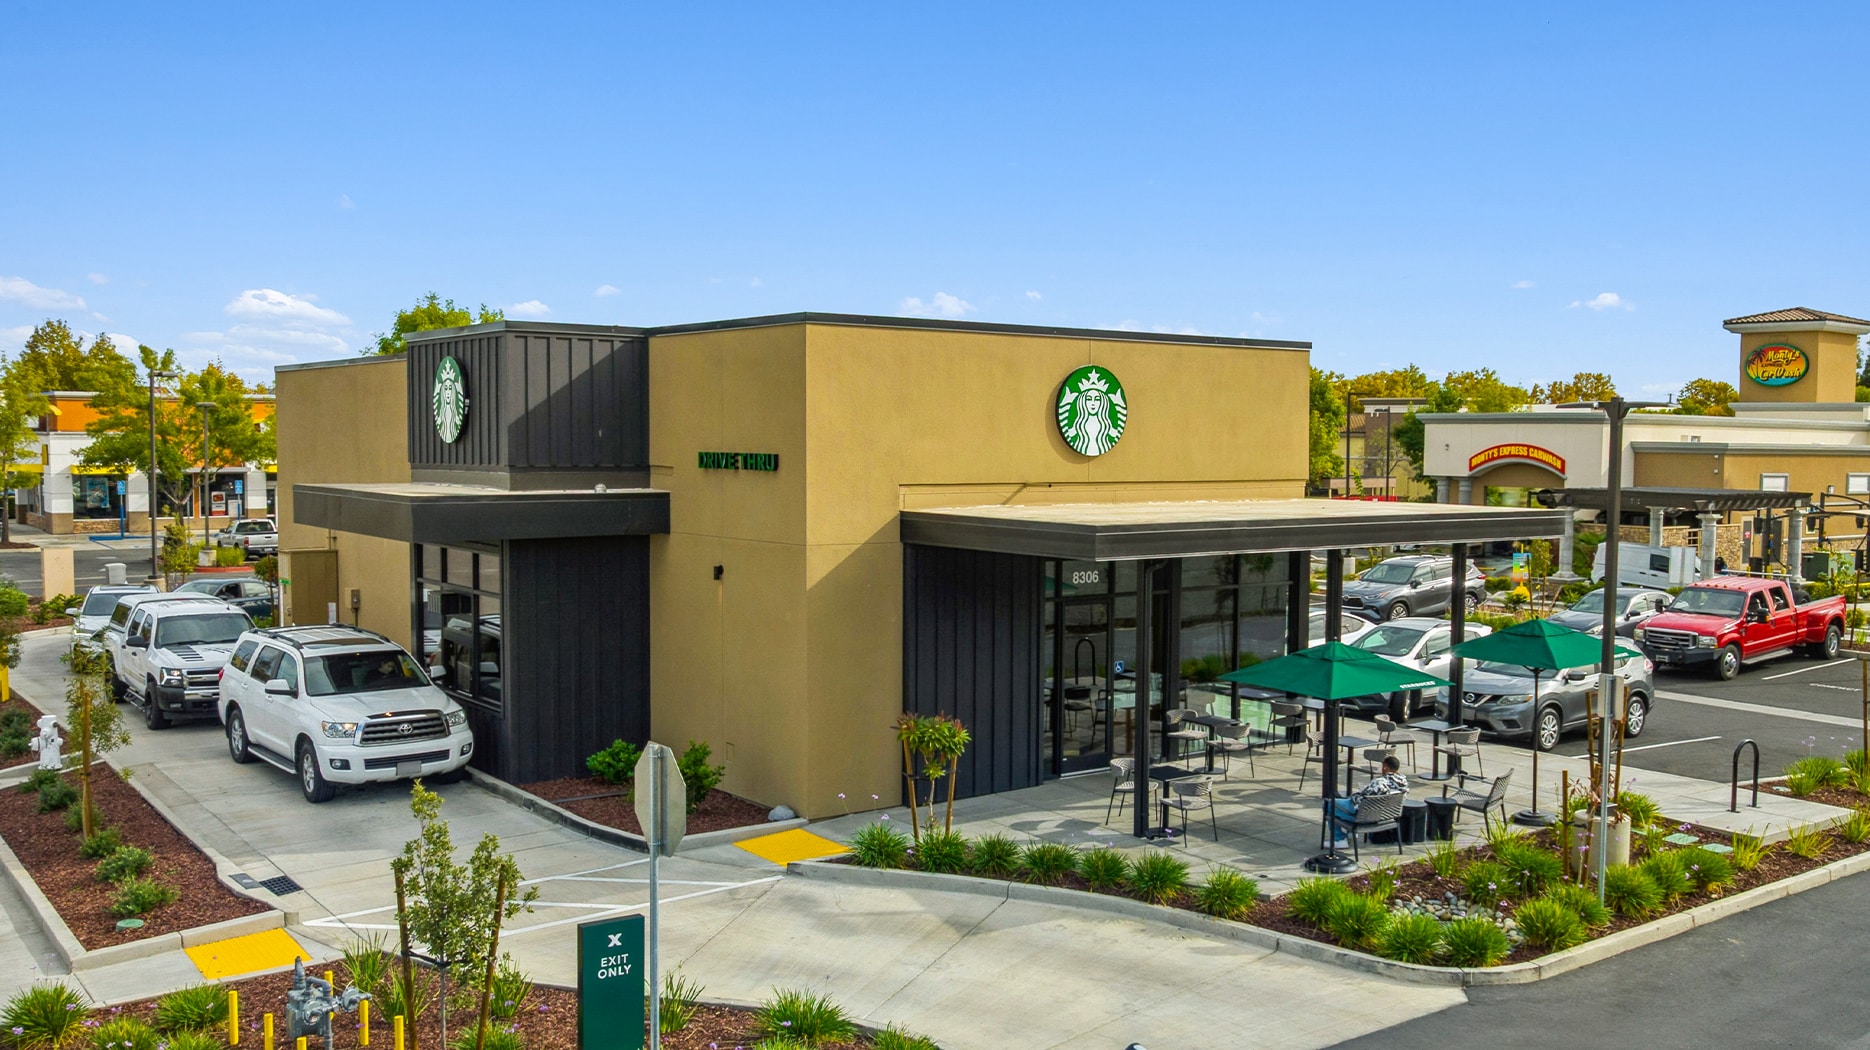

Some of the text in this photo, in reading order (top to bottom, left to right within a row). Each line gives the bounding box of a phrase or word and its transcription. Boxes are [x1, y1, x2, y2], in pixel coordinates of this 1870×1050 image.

[1766, 349, 1801, 365] Monty's
[698, 452, 779, 472] DRIVE THRU
[1471, 446, 1562, 470] MONTY'S EXPRESS CARWASH
[1072, 570, 1099, 584] 8306
[600, 953, 629, 968] EXIT
[597, 964, 632, 979] ONLY
